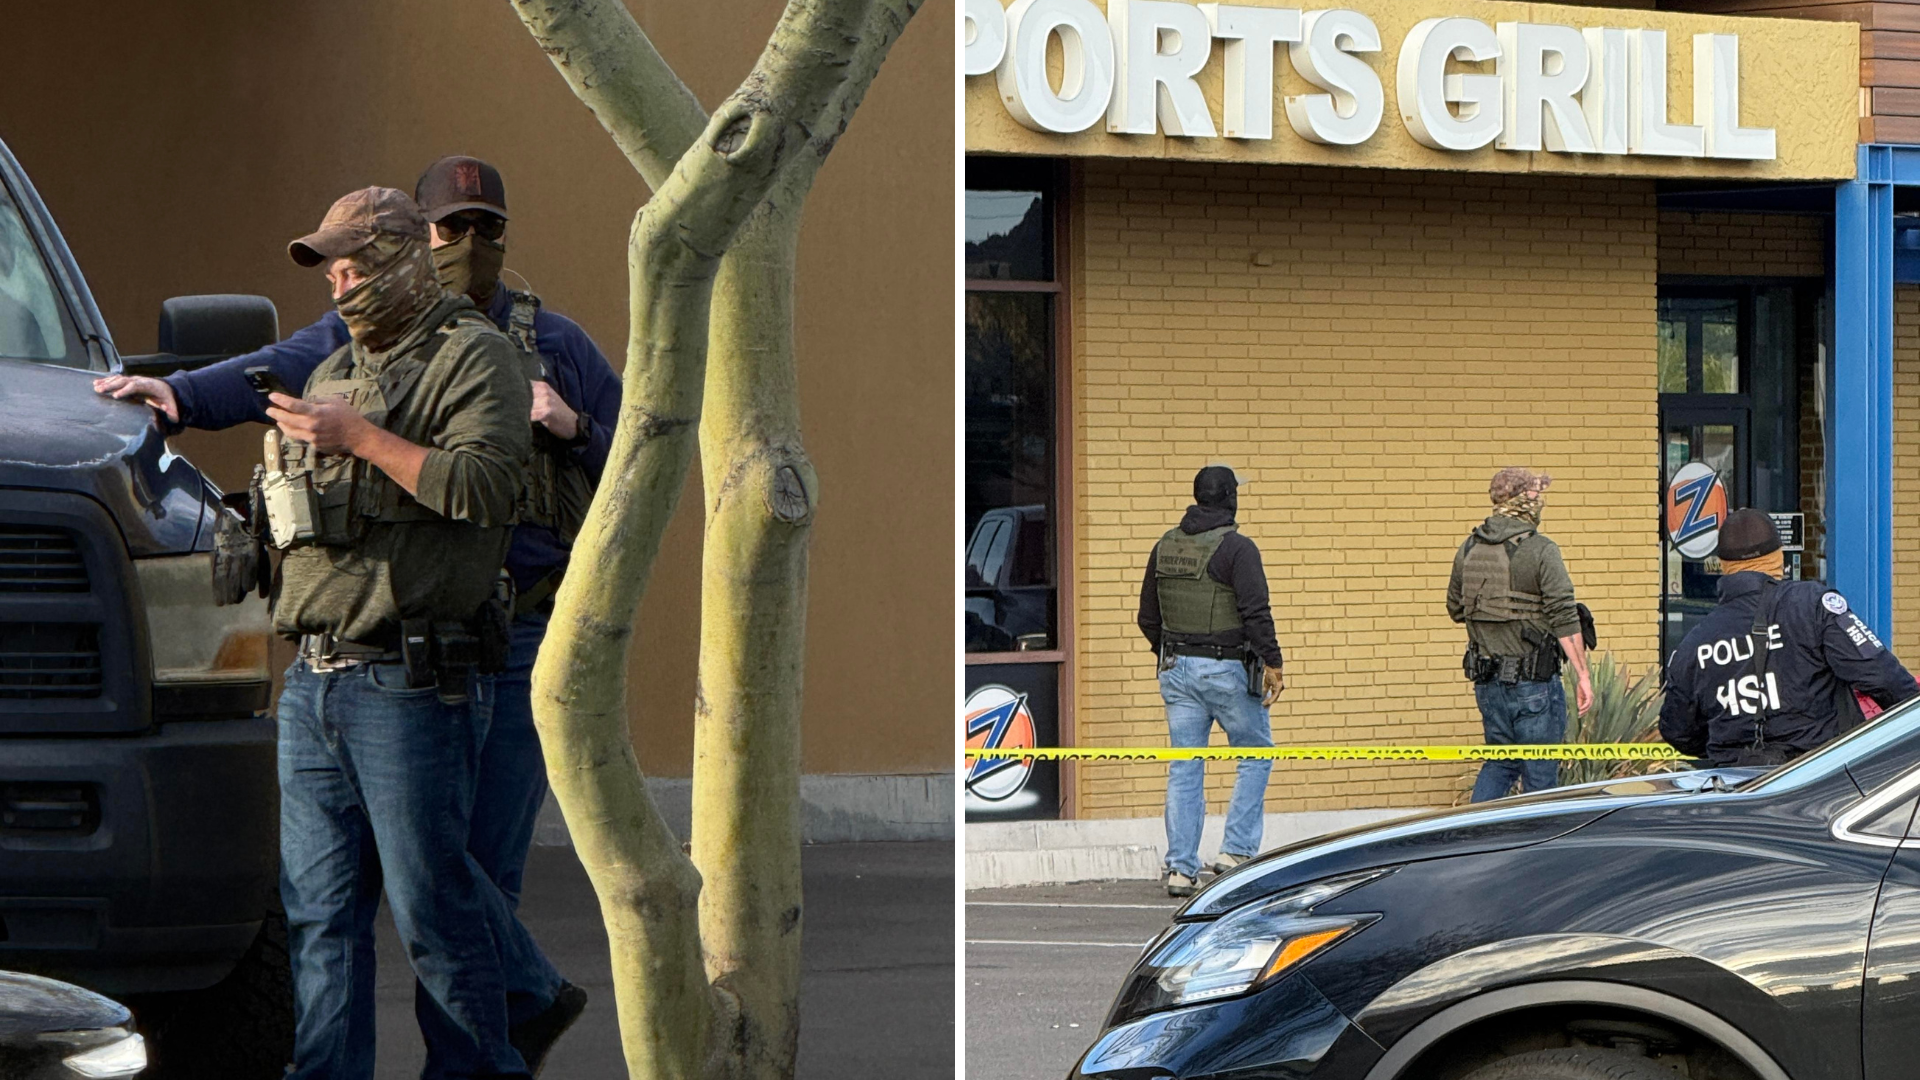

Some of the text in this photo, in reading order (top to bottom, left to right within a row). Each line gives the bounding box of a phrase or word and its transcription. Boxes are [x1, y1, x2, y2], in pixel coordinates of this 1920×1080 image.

[1397, 16, 1776, 160] GRILL
[1697, 624, 1784, 669] POLIE
[1846, 625, 1867, 646] HSI
[1849, 613, 1883, 648] POLICE
[1716, 671, 1780, 716] HSI
